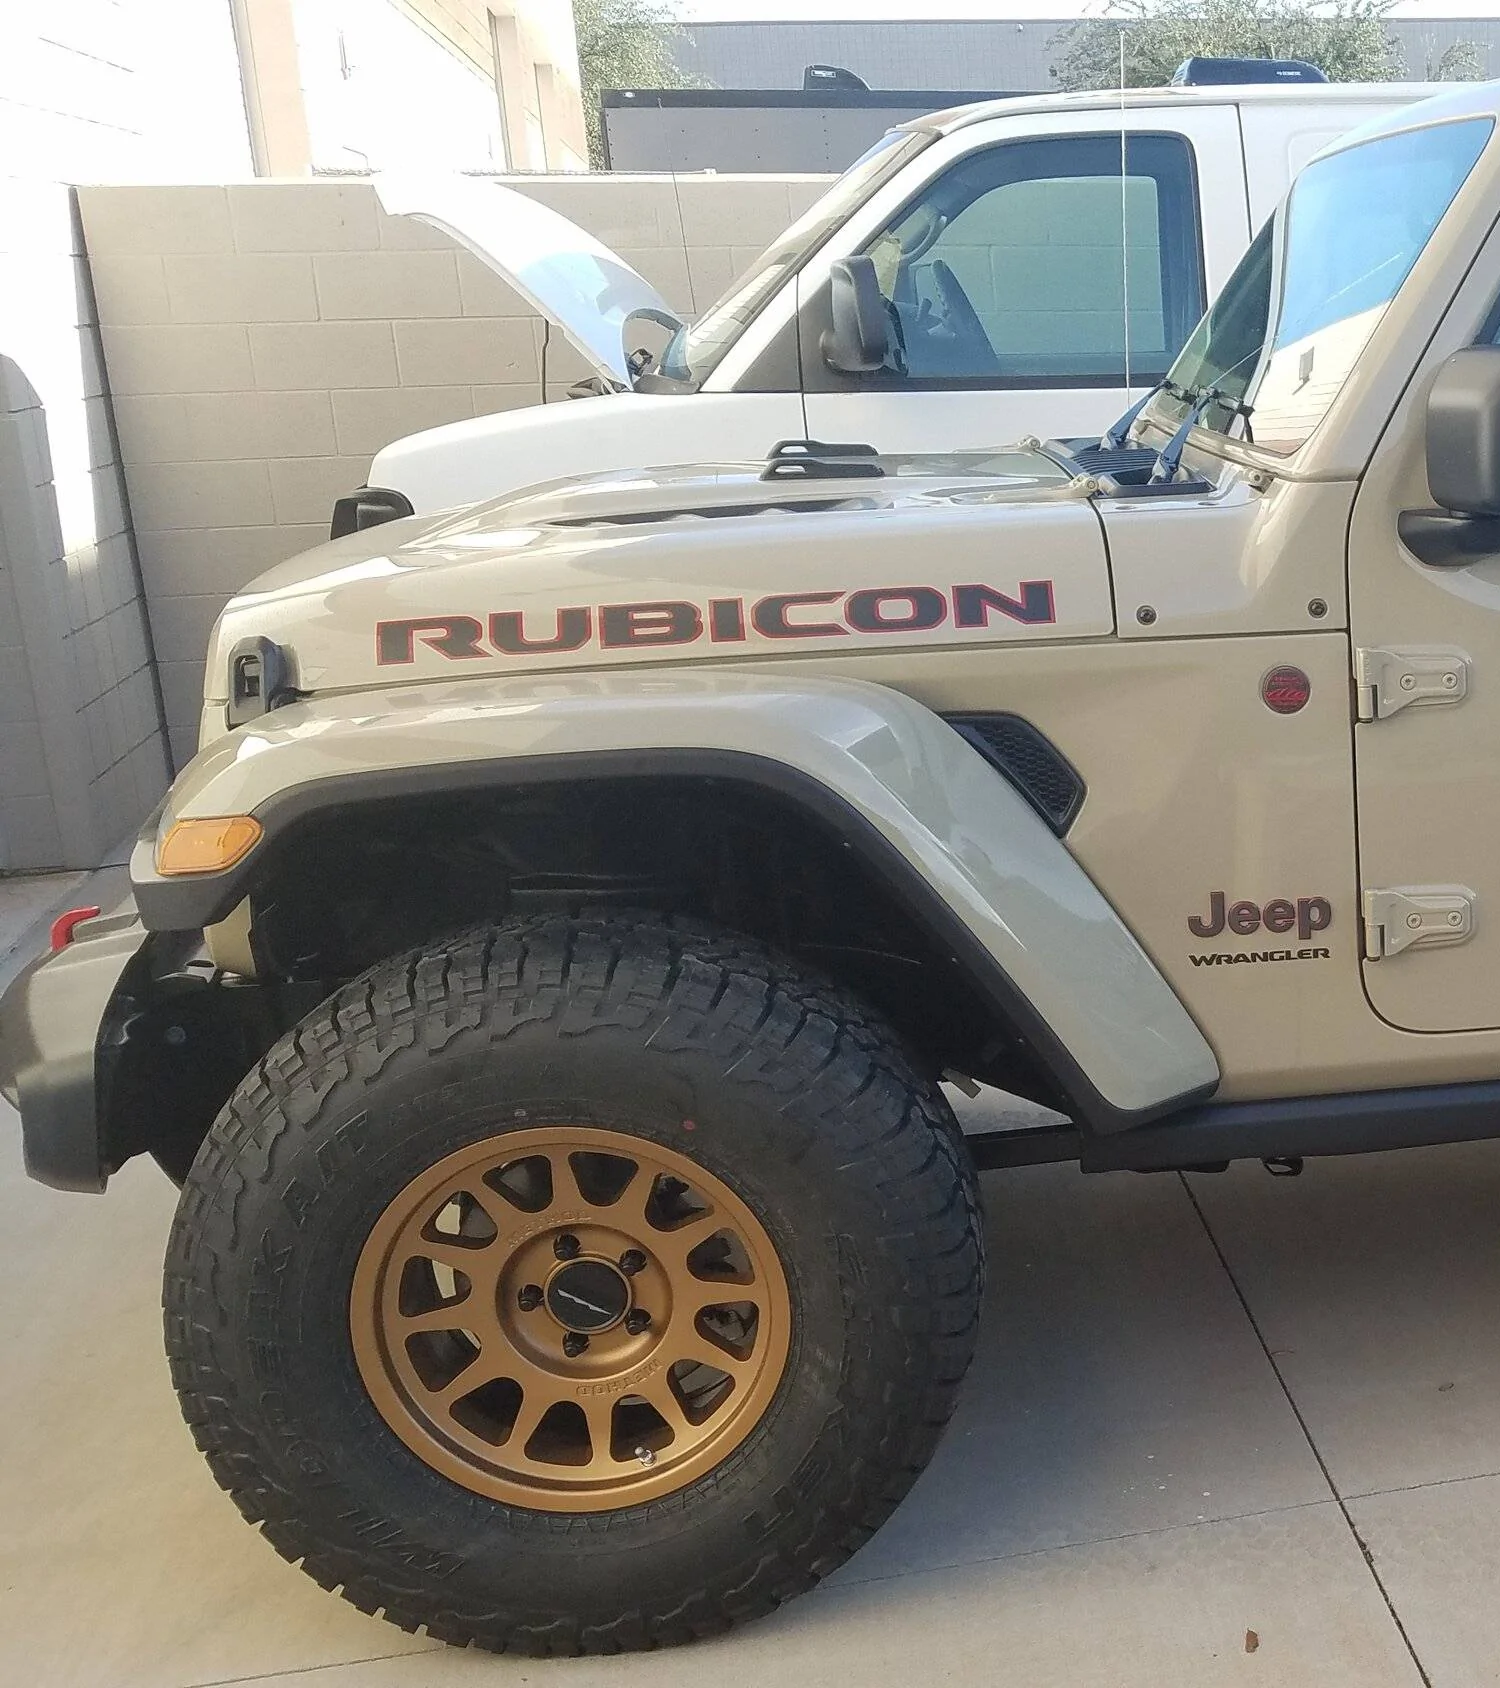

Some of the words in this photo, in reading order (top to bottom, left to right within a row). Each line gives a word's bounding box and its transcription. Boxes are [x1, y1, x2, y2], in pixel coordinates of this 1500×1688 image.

[376, 579, 1056, 666] RUBICON
[1187, 890, 1332, 940] Jeep
[1188, 947, 1331, 967] WRANGLER
